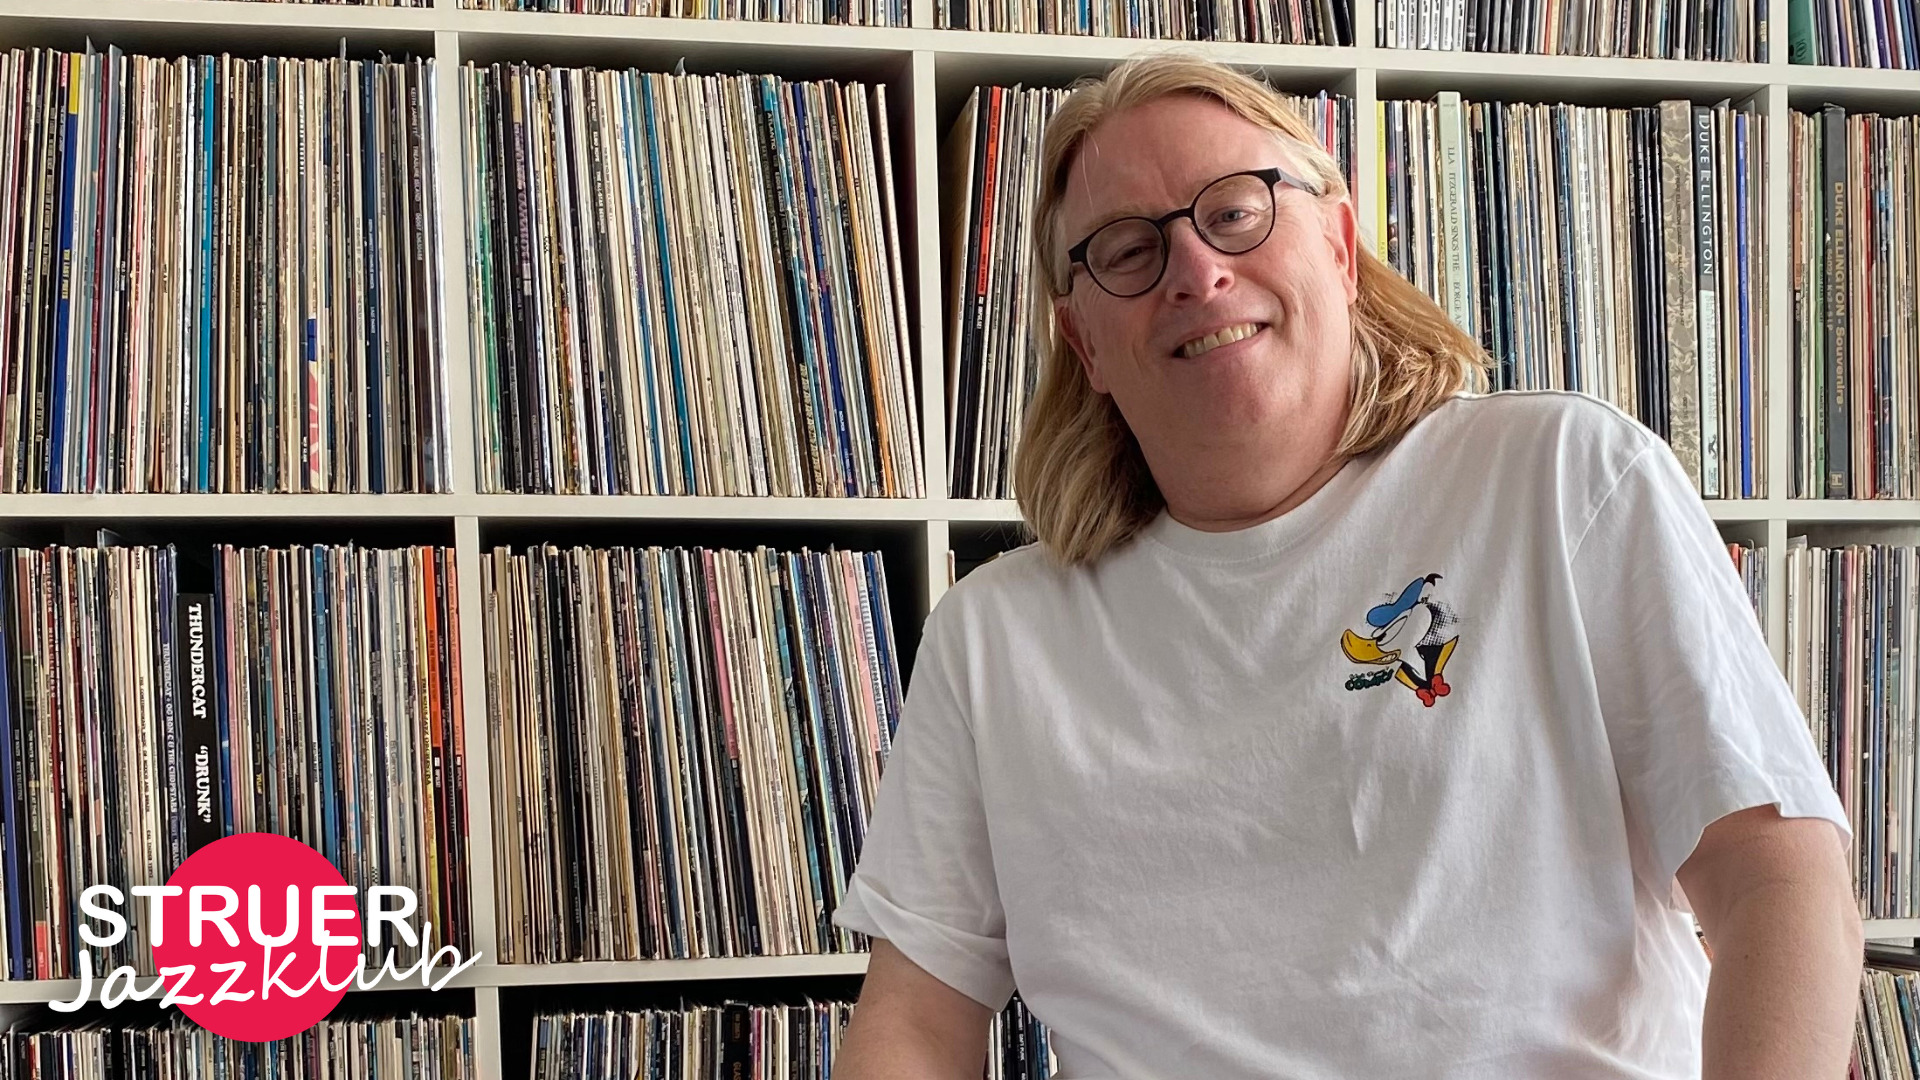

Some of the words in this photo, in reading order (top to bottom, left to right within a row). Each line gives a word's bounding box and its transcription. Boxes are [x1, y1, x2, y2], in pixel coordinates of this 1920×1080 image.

[767, 112, 777, 150] ATLANTIC
[1698, 114, 1711, 164] DUKE
[412, 146, 420, 178] TREASURE
[1449, 172, 1457, 224] ITZGERALD
[1700, 170, 1713, 275] ELLINGTON
[1835, 182, 1844, 226] DUKE
[1835, 229, 1845, 316] ELLINGTON
[1836, 326, 1846, 405] Souvenirs
[163, 643, 172, 697] THUNDERCAT
[188, 603, 206, 719] THUNDERCAT
[166, 717, 174, 734] RON
[168, 749, 176, 765] THE
[169, 766, 177, 813] CHOPSTARS
